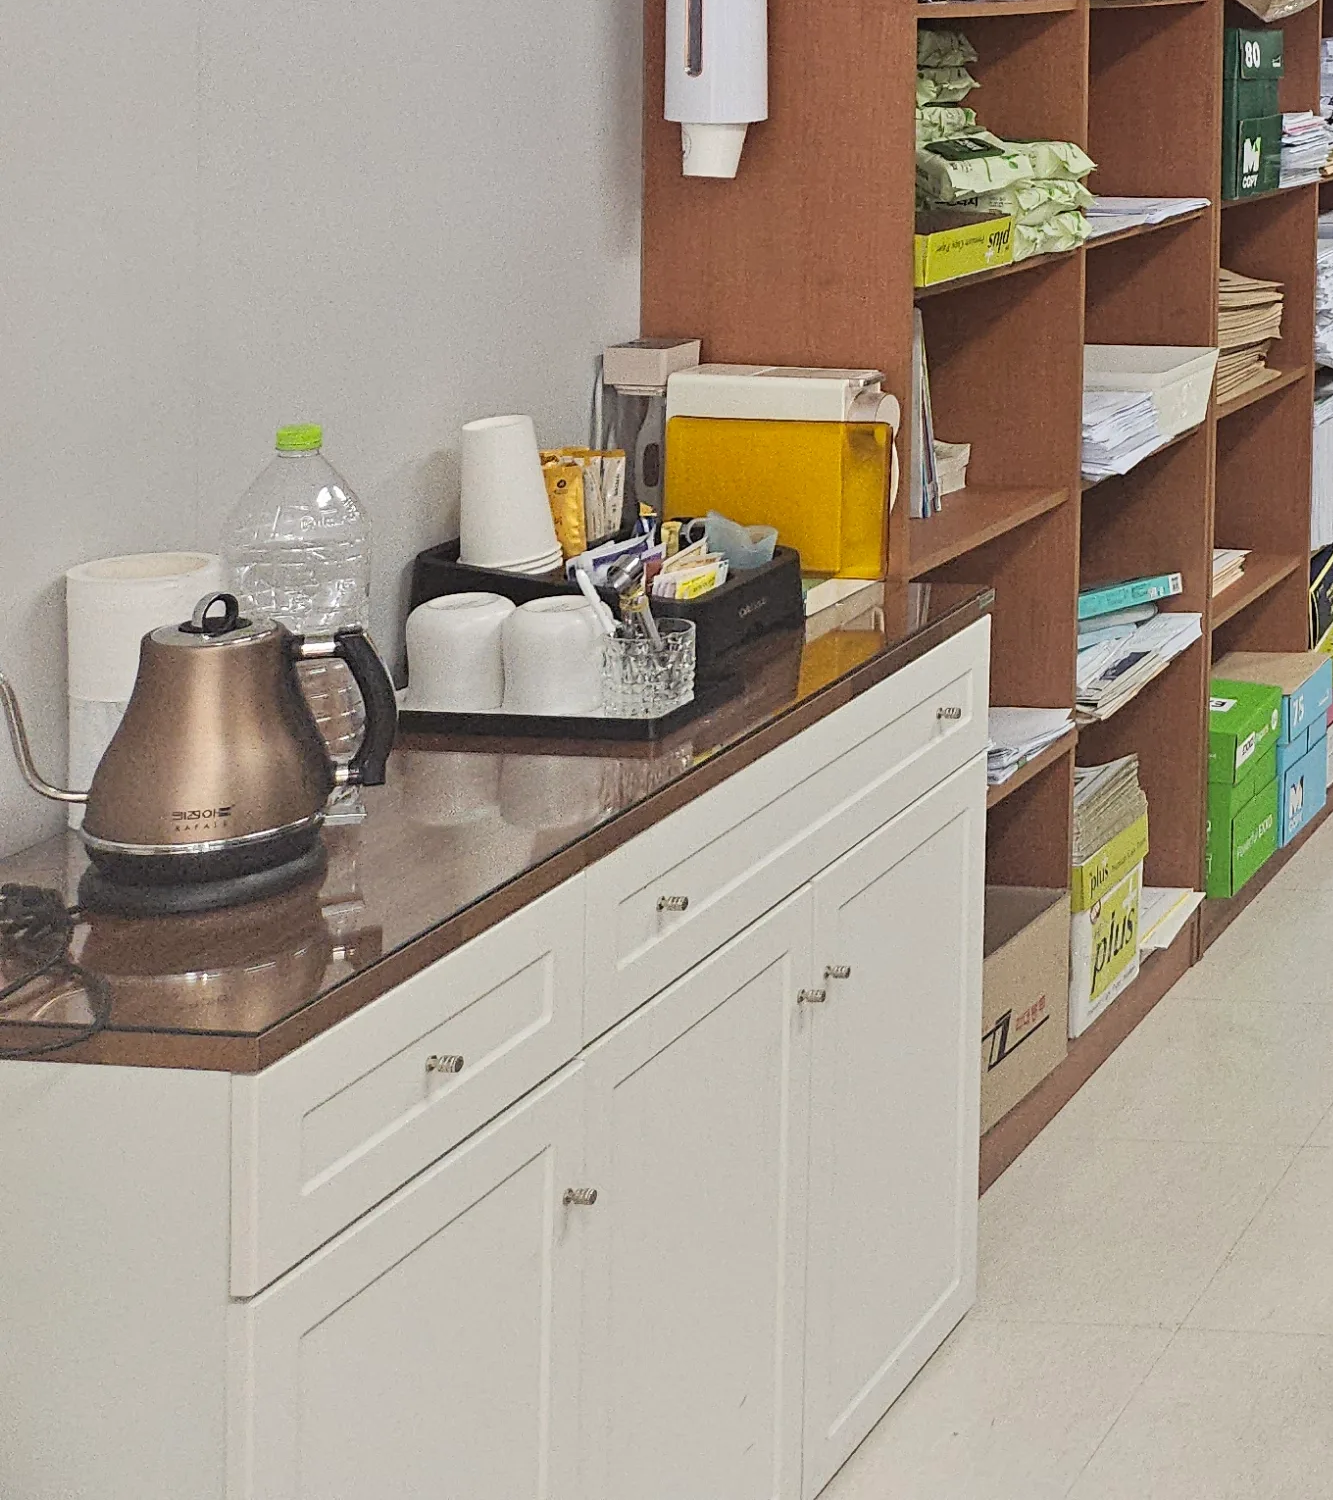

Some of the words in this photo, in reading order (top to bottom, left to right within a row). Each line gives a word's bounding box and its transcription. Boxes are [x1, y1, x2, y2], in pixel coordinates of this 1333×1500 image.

[1244, 41, 1261, 68] 80
[1242, 175, 1258, 188] COPY
[987, 221, 1011, 253] plus
[1292, 695, 1304, 728] 75
[1090, 864, 1109, 899] plus
[1091, 907, 1135, 996] plus
